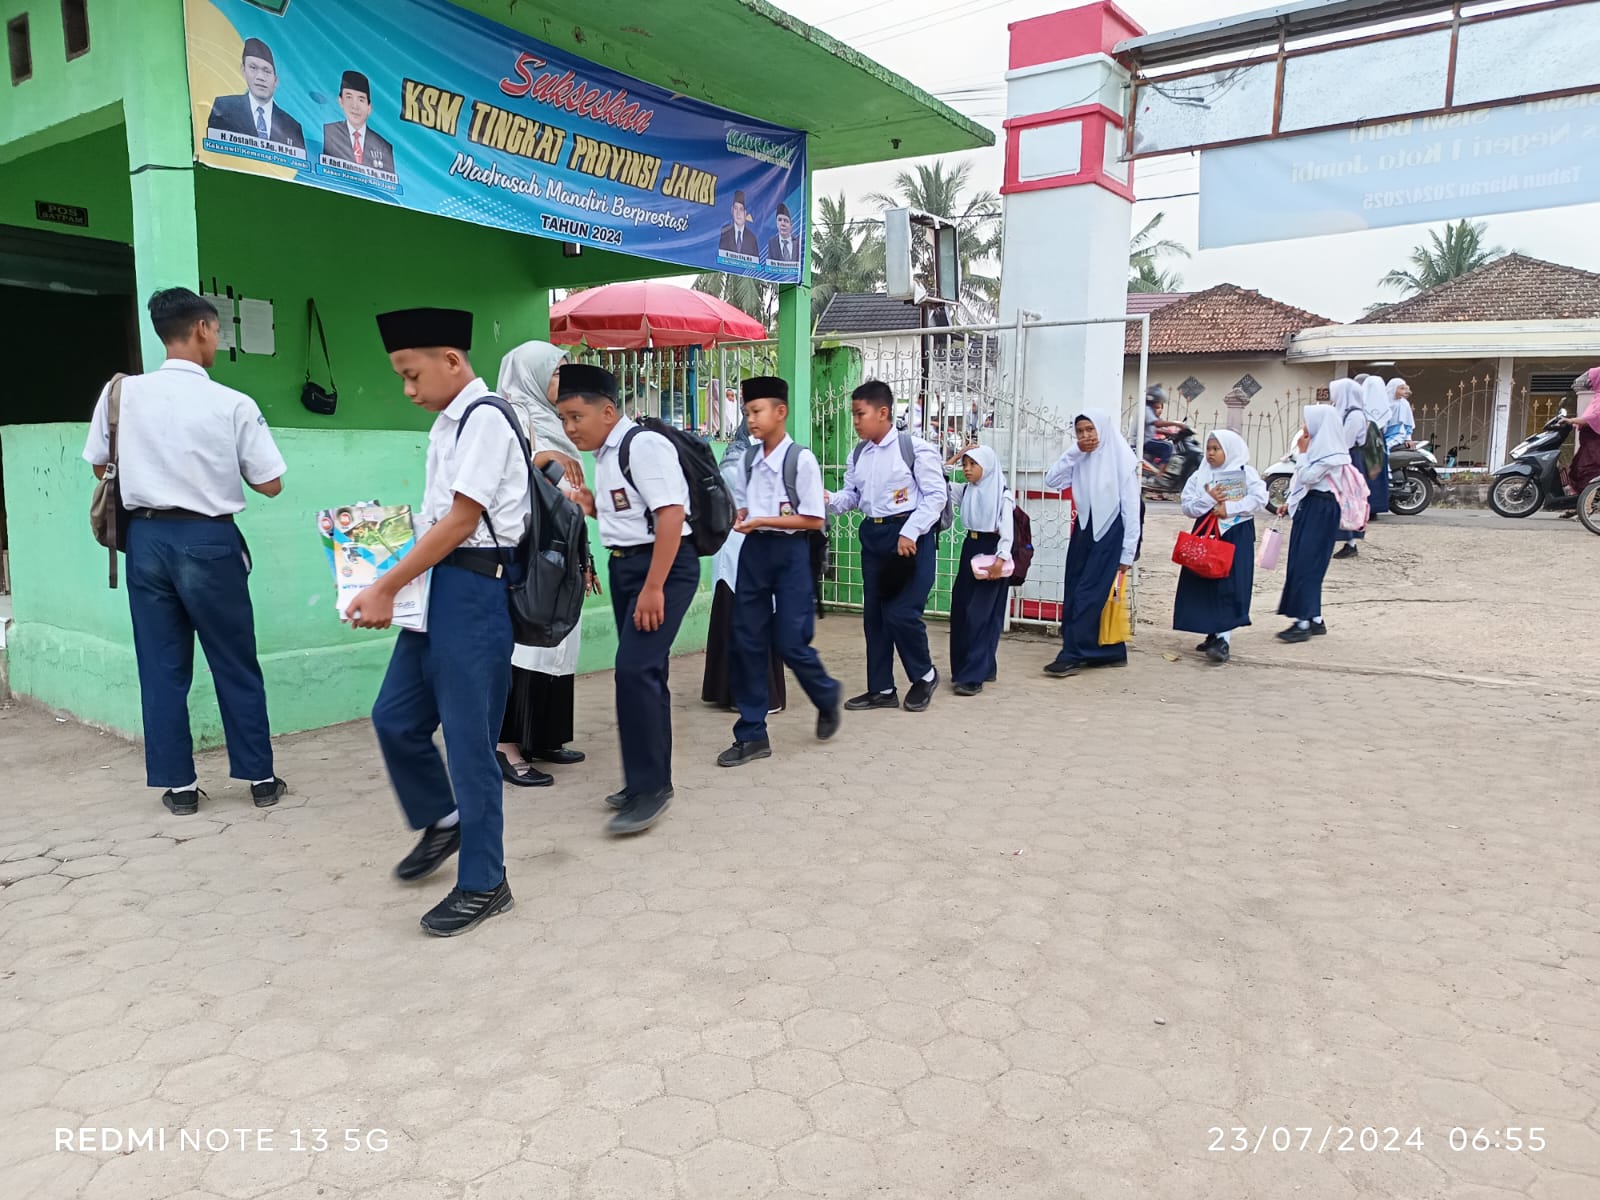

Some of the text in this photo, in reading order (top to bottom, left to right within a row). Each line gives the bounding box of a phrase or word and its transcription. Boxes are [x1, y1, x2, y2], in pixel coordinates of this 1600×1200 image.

[500, 51, 656, 135] Sukseskan
[401, 78, 719, 207] KSM TINGKAT PROVINSI JAMBI
[41, 212, 84, 225] SATPAM
[47, 204, 78, 218] POS
[449, 151, 690, 233] Madrasah Mandiri Berprestasi
[541, 214, 623, 245] TAHUN 2024
